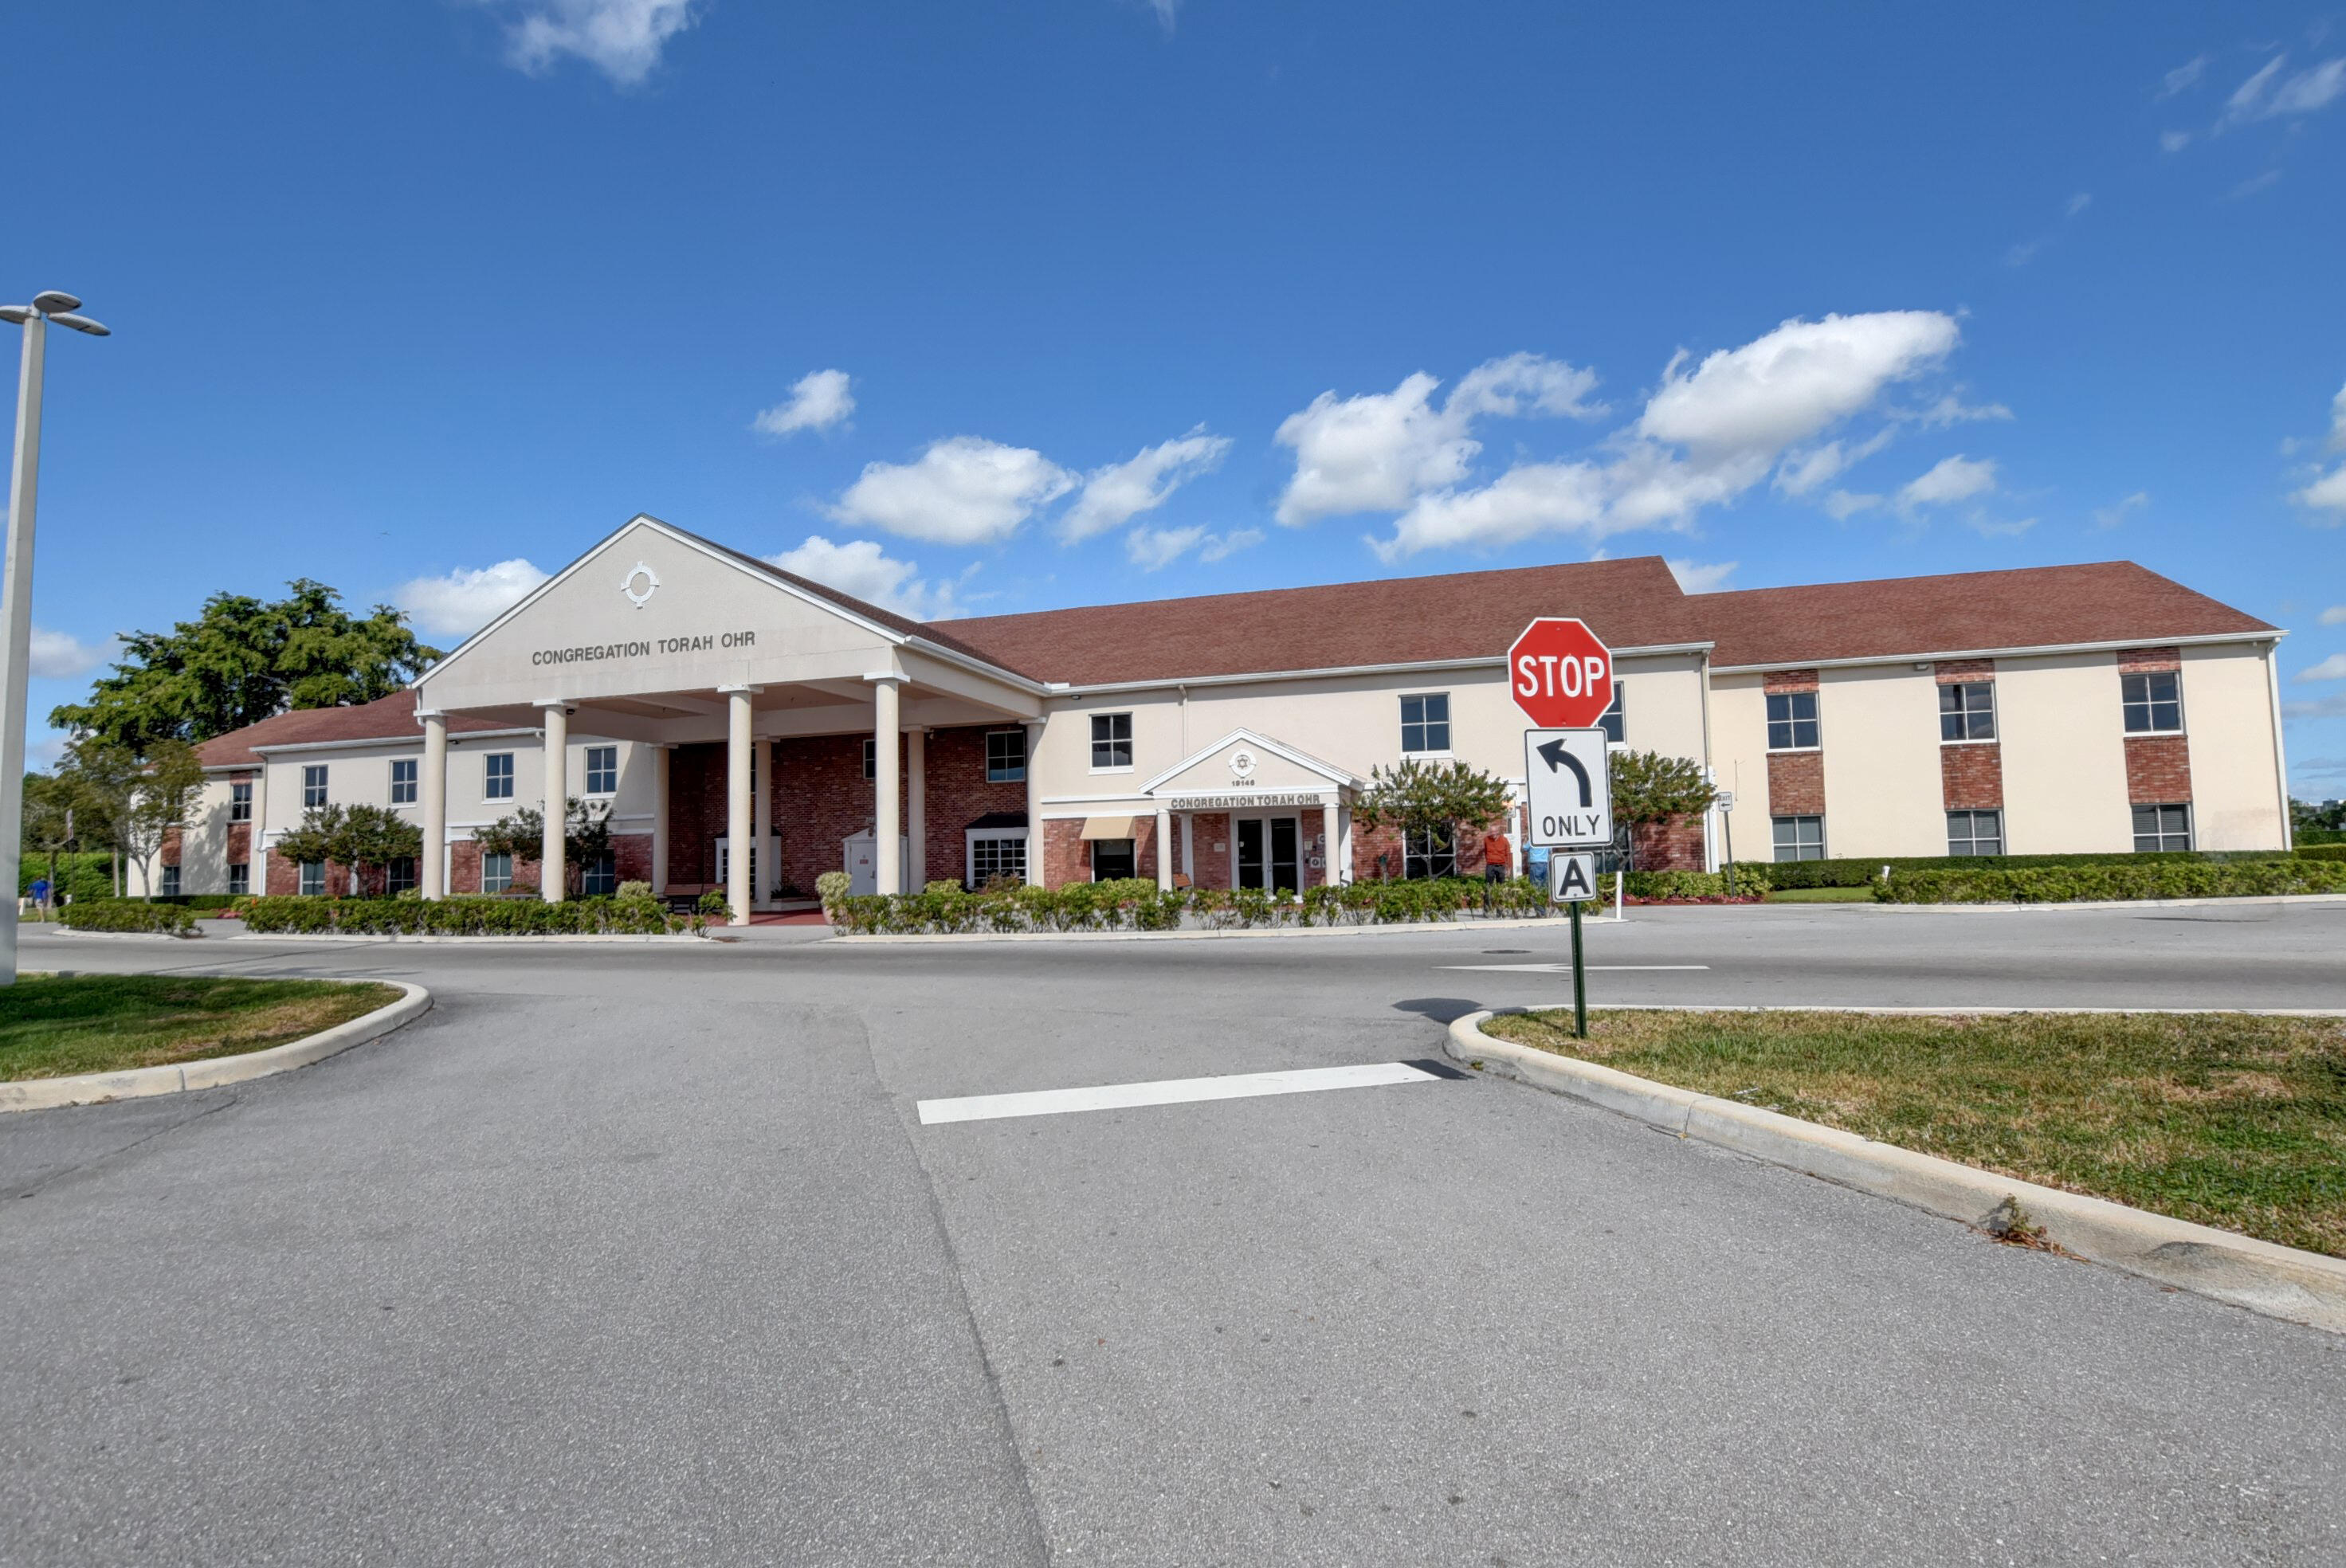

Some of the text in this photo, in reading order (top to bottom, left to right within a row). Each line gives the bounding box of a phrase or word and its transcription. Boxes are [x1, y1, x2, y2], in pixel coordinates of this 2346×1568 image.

[532, 631, 755, 664] CONGREGATION TORAH OHR
[1517, 655, 1605, 697] STOP
[1171, 794, 1320, 809] CONGREGATION TORAH OHR
[1543, 814, 1600, 837] ONLY
[1559, 858, 1591, 896] A
